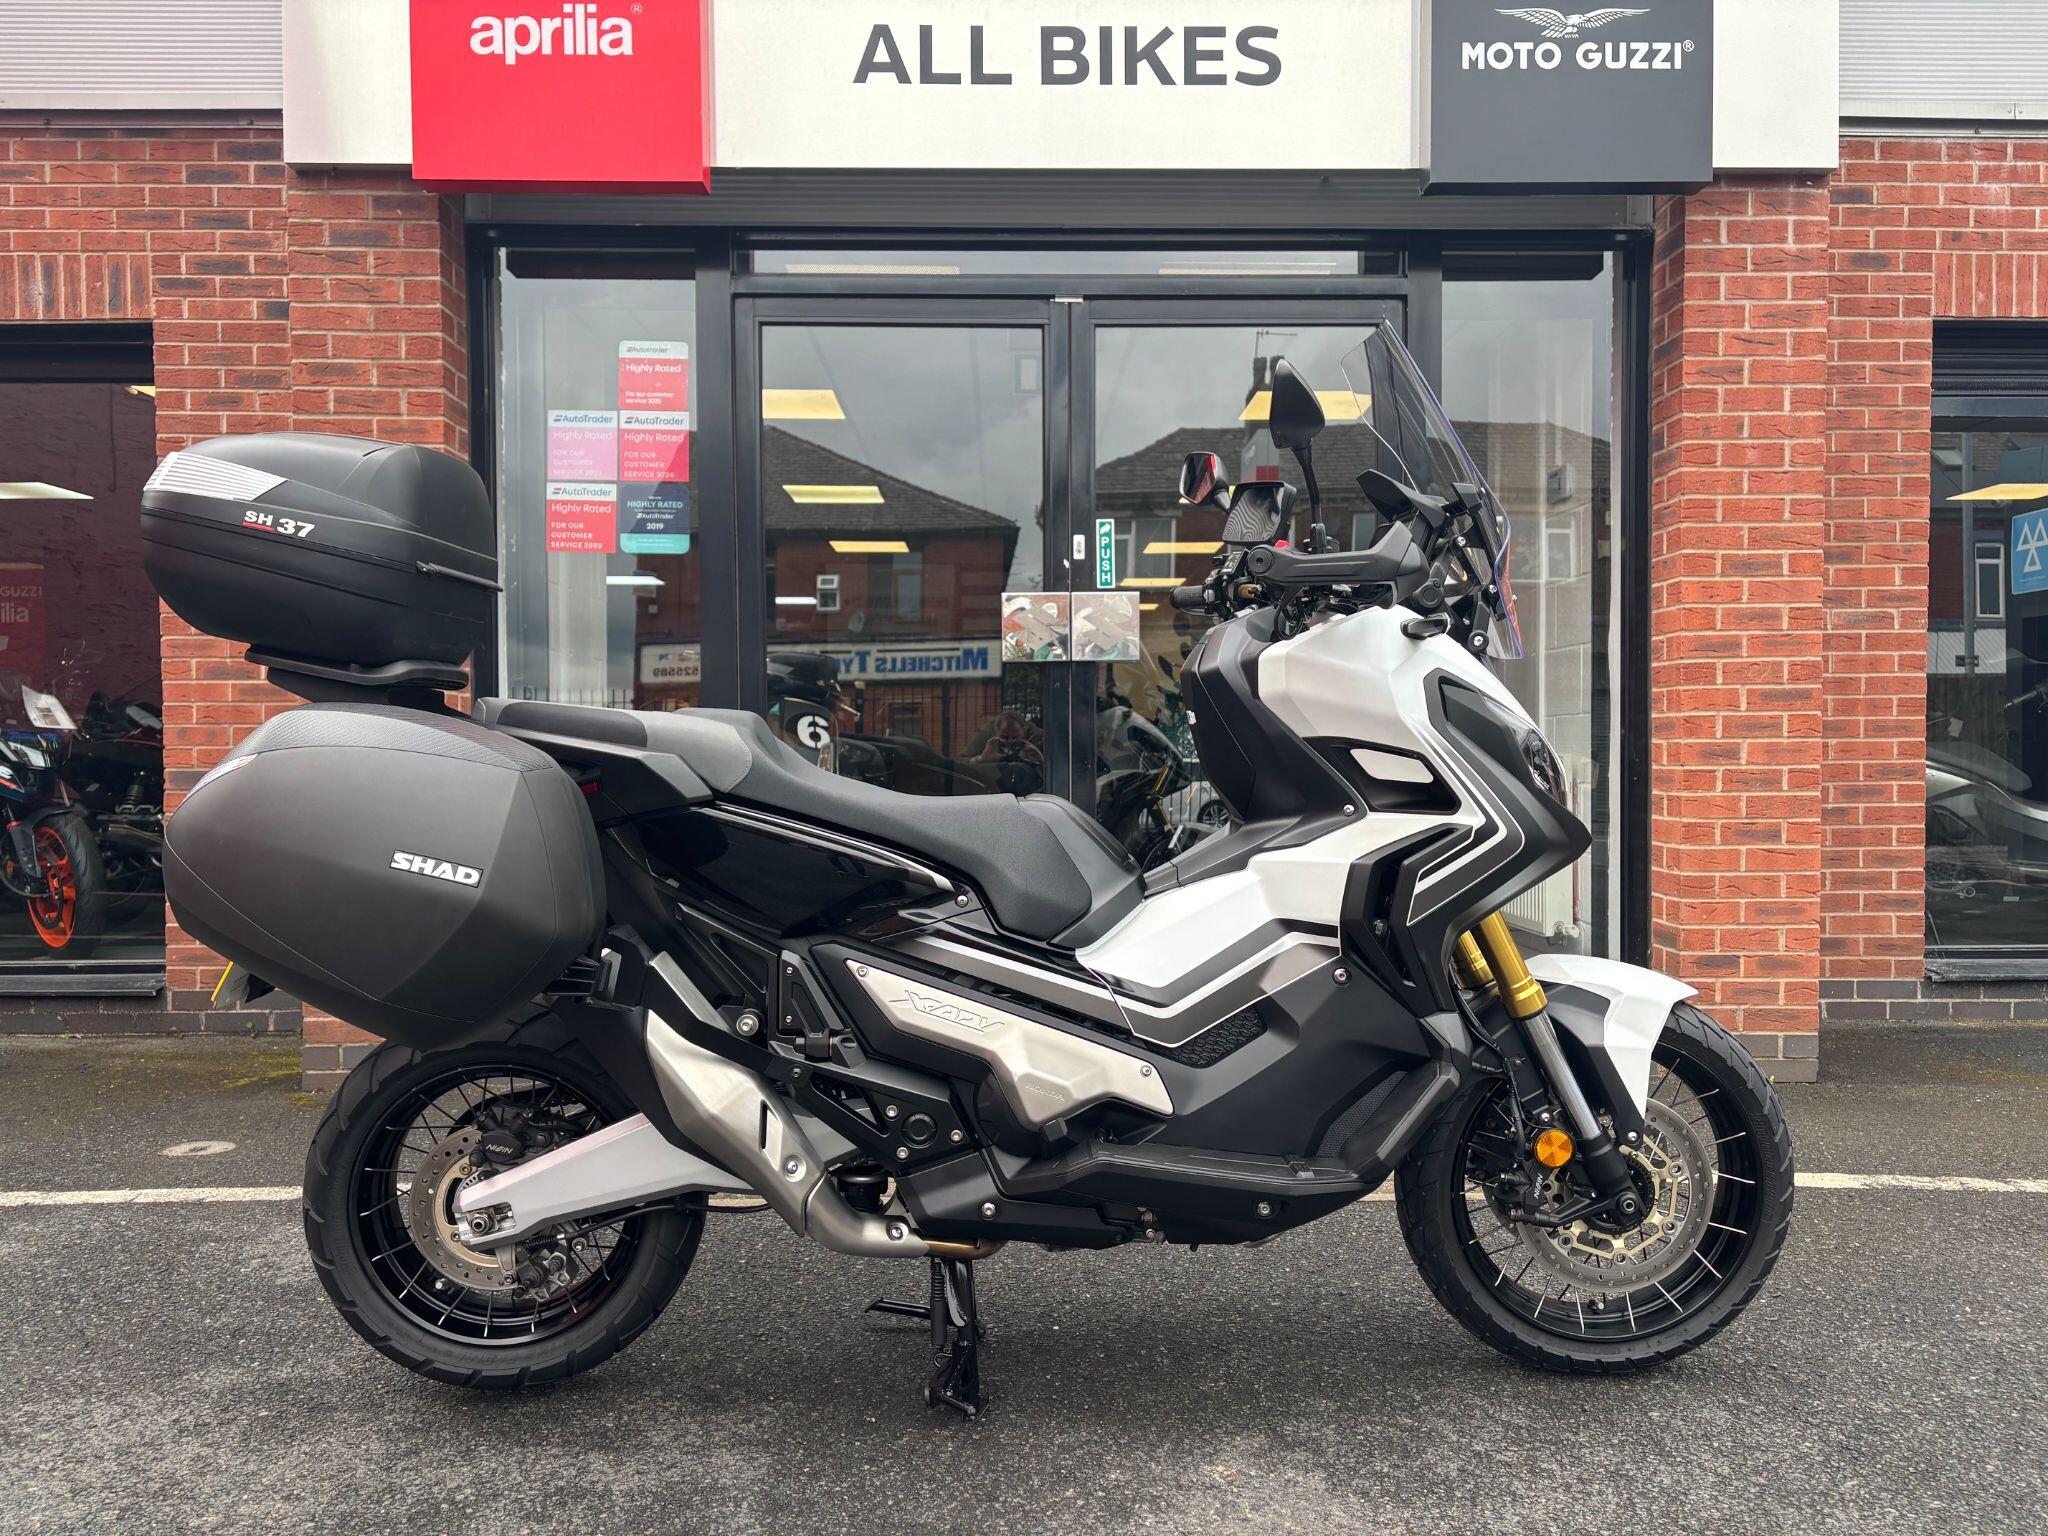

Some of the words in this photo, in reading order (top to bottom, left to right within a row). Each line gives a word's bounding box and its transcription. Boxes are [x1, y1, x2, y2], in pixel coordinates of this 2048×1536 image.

[852, 24, 1013, 85] ALL
[1040, 25, 1282, 86] BIKES
[1461, 41, 1562, 70] MOTO
[625, 364, 654, 374] Highly
[655, 364, 681, 373] Rated
[562, 414, 614, 424] AutoTrader
[634, 416, 684, 425] AutoTrader
[553, 431, 583, 442] Highly
[584, 431, 613, 441] Rated
[624, 432, 654, 443] Highly
[655, 433, 684, 442] Rated
[561, 487, 612, 497] AutoTrader
[551, 503, 581, 514] Highly
[583, 504, 611, 513] Rated
[627, 500, 656, 508] HIGHLY
[657, 501, 683, 509] RATED
[244, 510, 274, 526] SH
[276, 518, 316, 538] 37
[551, 521, 567, 529] FOR
[646, 522, 664, 530] 2019
[551, 531, 593, 539] CUSTOMER
[551, 541, 582, 549] SERVICE
[1101, 536, 1111, 583] PUSH
[0, 586, 43, 597] GUZZI
[390, 852, 480, 885] SHAD
